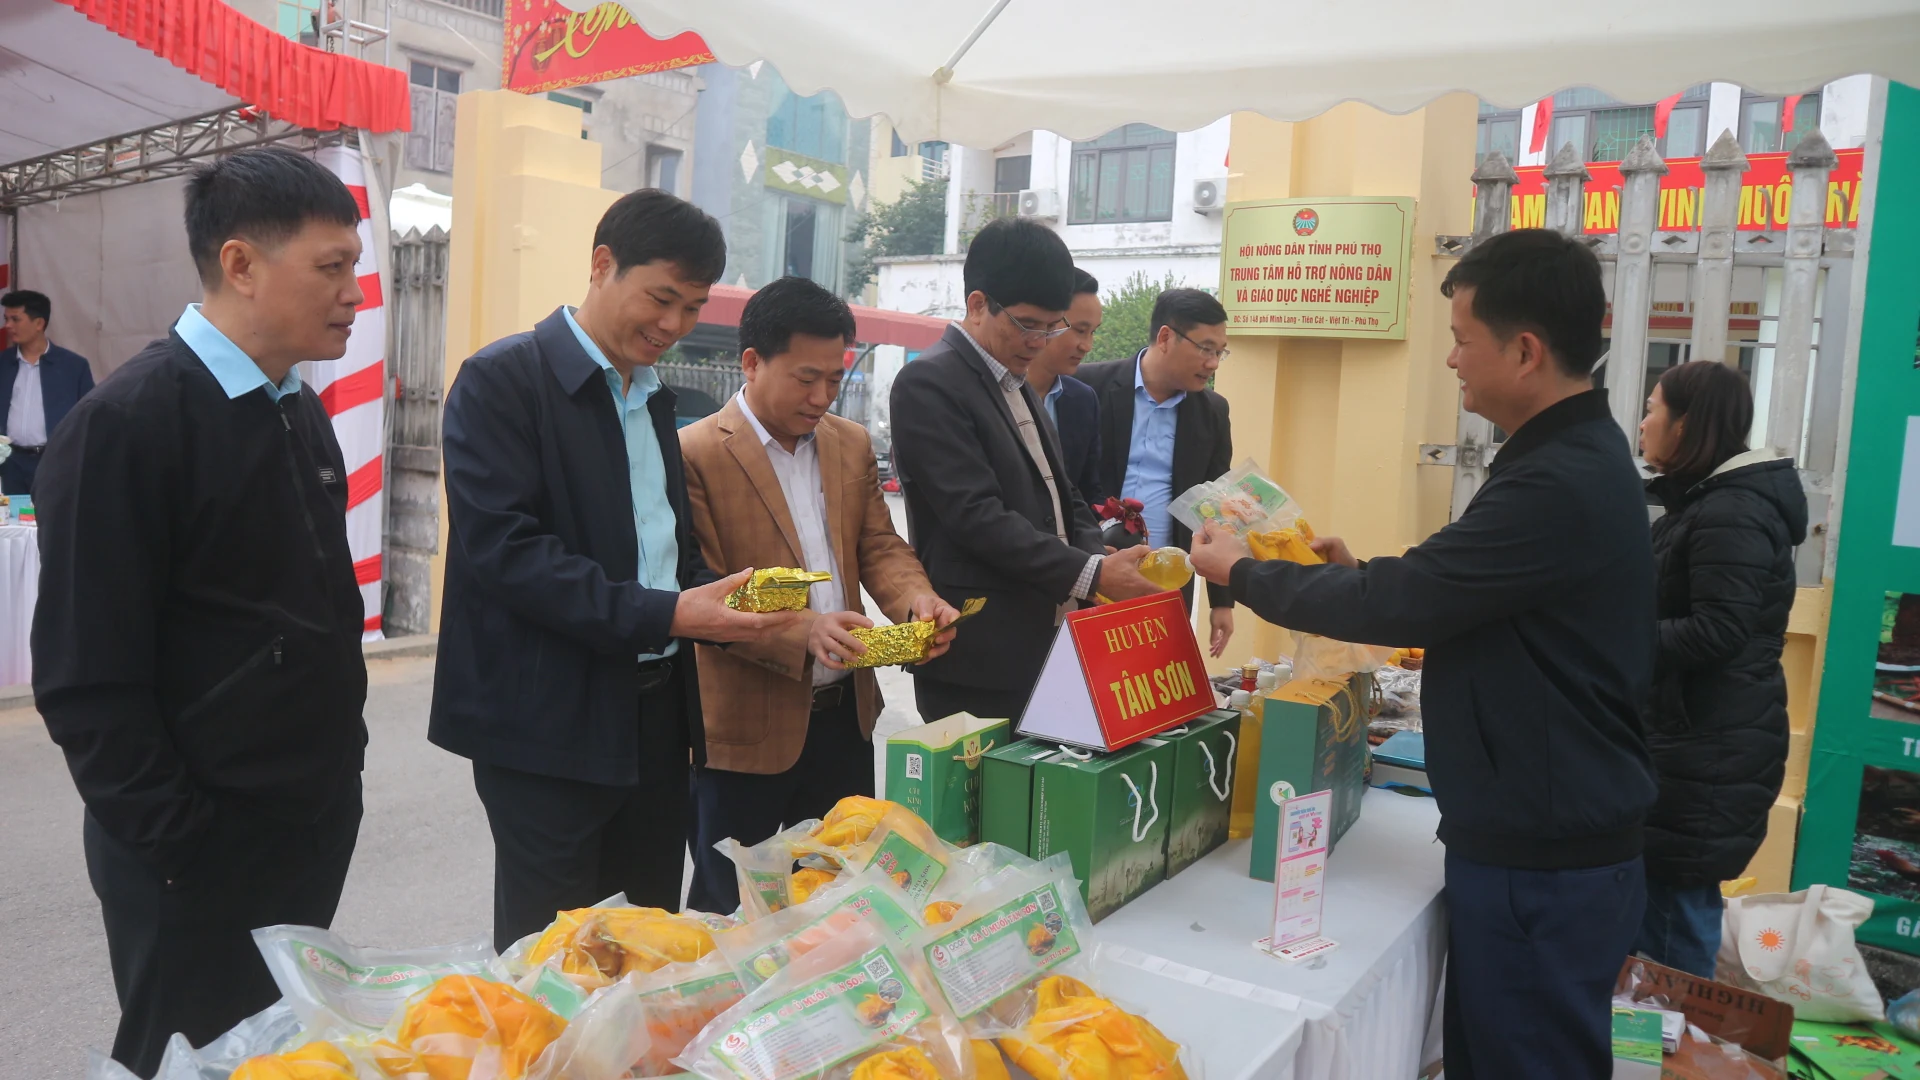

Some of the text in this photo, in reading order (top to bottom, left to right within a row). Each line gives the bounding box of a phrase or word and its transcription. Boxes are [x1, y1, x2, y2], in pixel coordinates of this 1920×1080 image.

[1737, 175, 1792, 225] MUÔ
[1240, 240, 1382, 259] HỘI NÔNG DÂN TỈNH PHÚ THỌ
[1230, 261, 1392, 283] TRUNG TÂM HỖ TRỢ NÔNG DÂN
[1237, 284, 1380, 307] VÀ GIÁO DỤC NGHỀ NGHIỆP
[1269, 314, 1283, 323] Minh
[1283, 315, 1297, 324] Lang
[1329, 315, 1341, 326] Việt
[1368, 317, 1379, 327] Thọ
[1103, 616, 1169, 654] HUYỆN
[1109, 659, 1197, 721] TÂN SƠN
[971, 930, 984, 943] GÀ
[989, 916, 1008, 934] MUỐI
[1021, 902, 1037, 918] SƠN
[802, 988, 829, 1007] MUỐI
